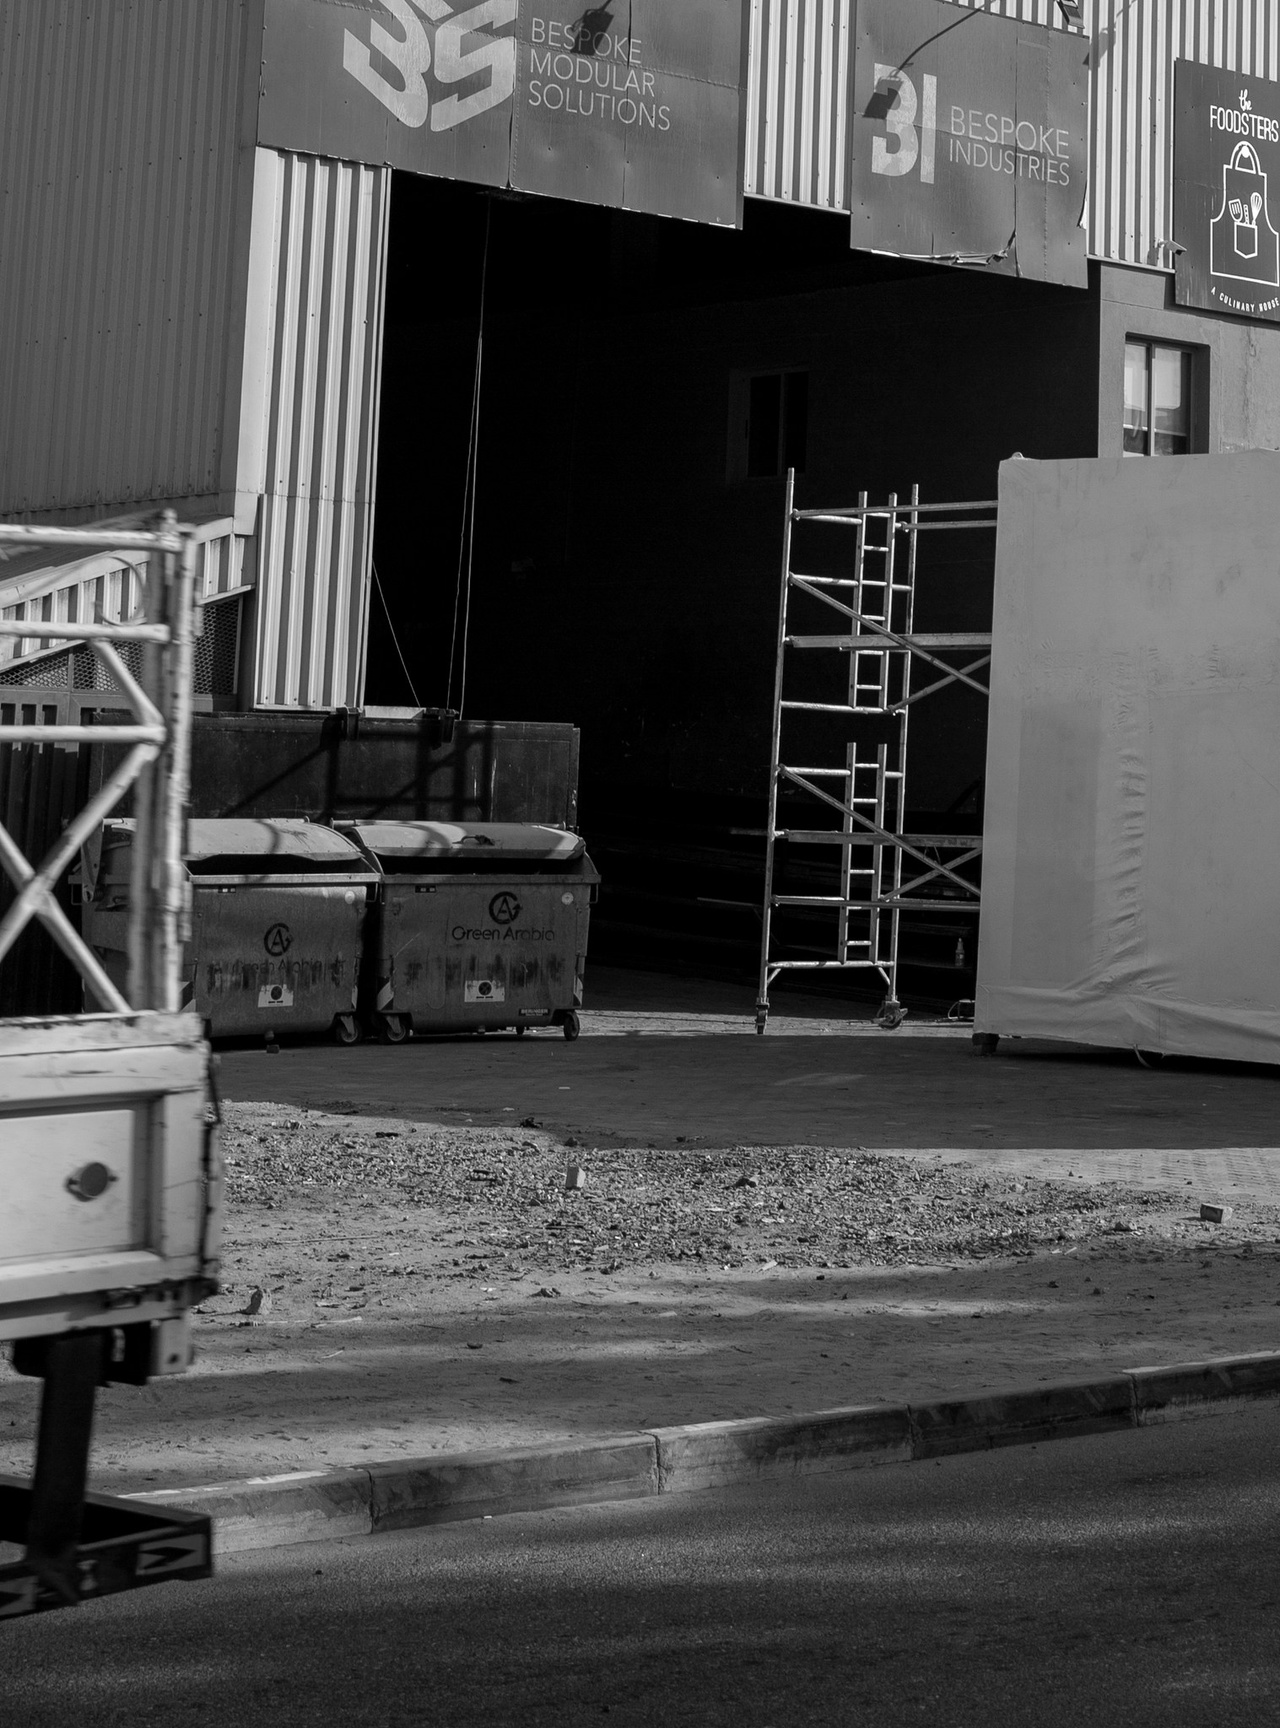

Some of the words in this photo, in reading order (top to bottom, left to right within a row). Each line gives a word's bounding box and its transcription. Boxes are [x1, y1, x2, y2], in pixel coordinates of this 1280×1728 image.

[532, 18, 642, 65] BESPOKE
[530, 48, 655, 97] MODULAR
[528, 81, 670, 131] SOLUTIONS
[1210, 105, 1279, 142] FOODSTERS
[1239, 89, 1252, 111] the
[951, 105, 1069, 159] BESPOKE
[950, 139, 1070, 186] INDUSTRIES
[1211, 286, 1216, 295] A
[1219, 292, 1255, 312] CULINARY
[1259, 297, 1280, 312] HOUSE
[452, 925, 500, 941] Green
[503, 926, 555, 941] Arabia
